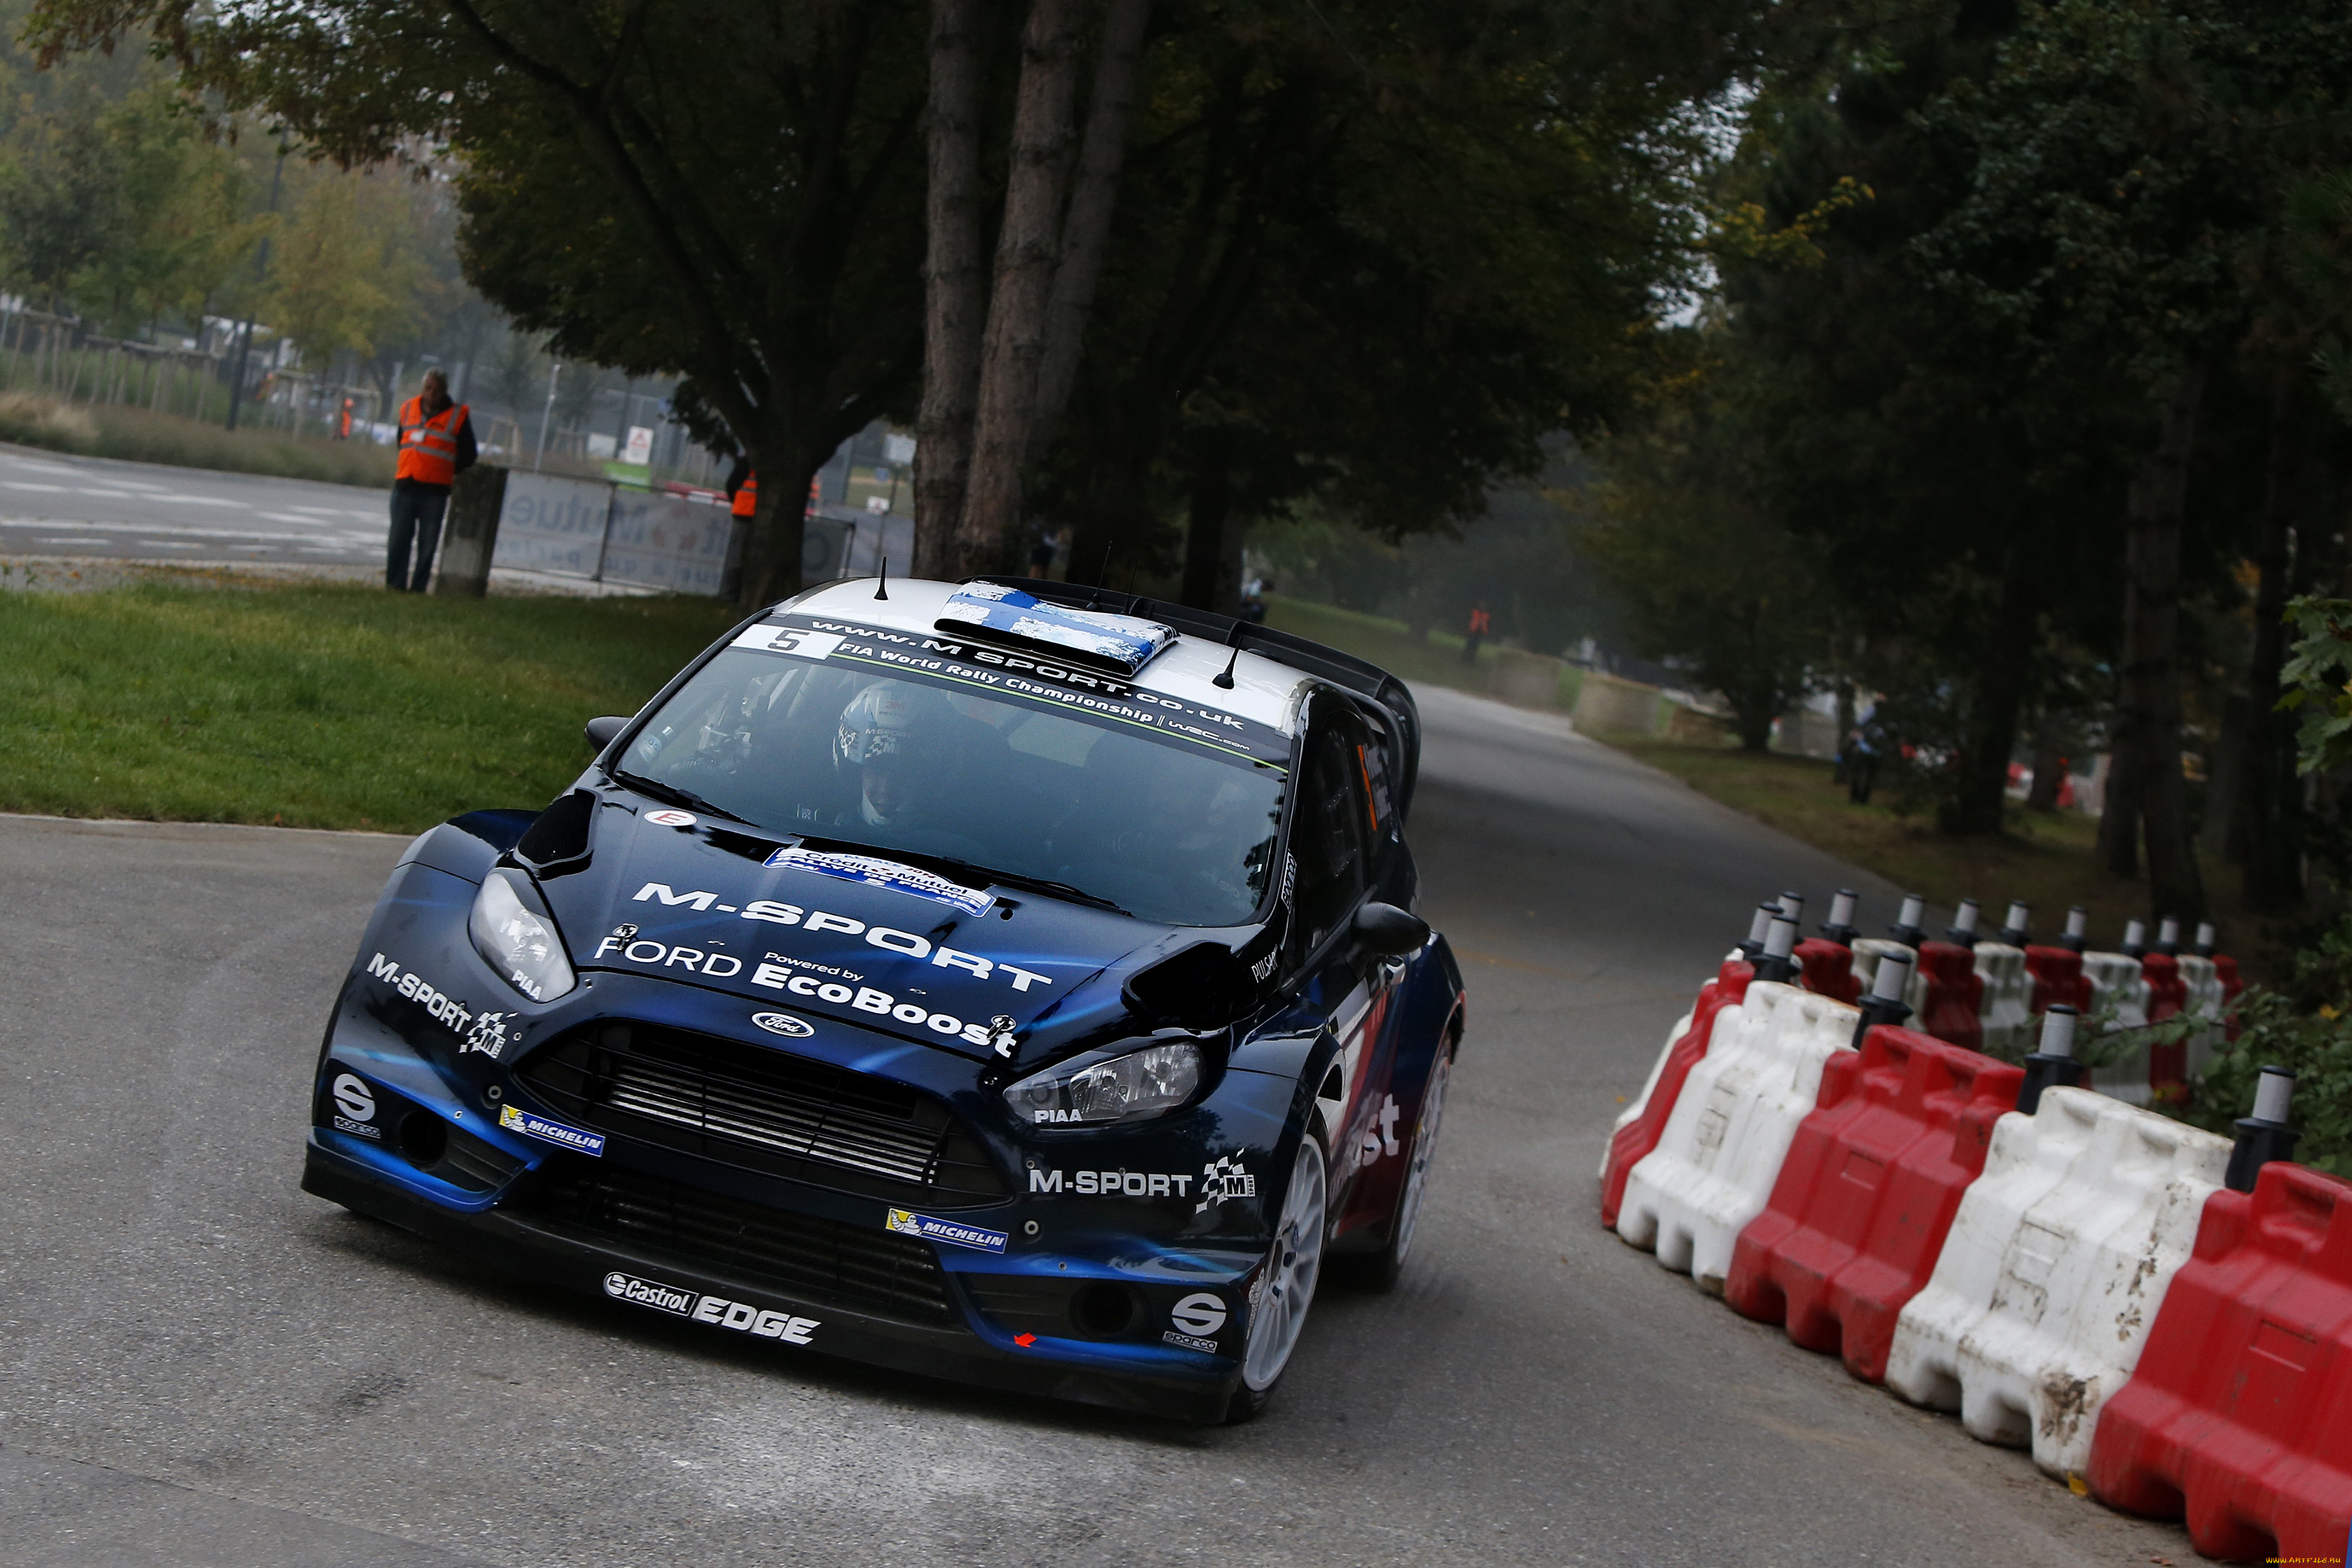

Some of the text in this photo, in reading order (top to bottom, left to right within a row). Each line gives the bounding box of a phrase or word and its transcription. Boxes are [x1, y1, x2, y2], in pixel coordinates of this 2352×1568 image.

[768, 629, 810, 651] 5
[837, 642, 873, 657] FIA
[880, 649, 943, 671] World
[945, 664, 1001, 684] Rally
[1005, 677, 1154, 723] Championship
[653, 812, 688, 824] E
[896, 873, 969, 895] Mutuel
[904, 868, 937, 879] 2014
[863, 872, 893, 882] DE
[898, 880, 982, 909] FRANCE
[632, 881, 1053, 993] M-SPORT
[594, 936, 742, 977] FORD
[764, 951, 864, 982] Powered by
[366, 952, 473, 1032] M-SPORT
[511, 969, 543, 1000] PIAA
[751, 962, 1017, 1058] EcoBoost
[1035, 1108, 1084, 1124] PIAA
[527, 1120, 602, 1149] MICHELIN
[1029, 1169, 1193, 1197] M-SPORT
[923, 1221, 1005, 1247] MICHELIN
[625, 1280, 822, 1345] Castrol EDGE
[1165, 1331, 1217, 1349] sparco
